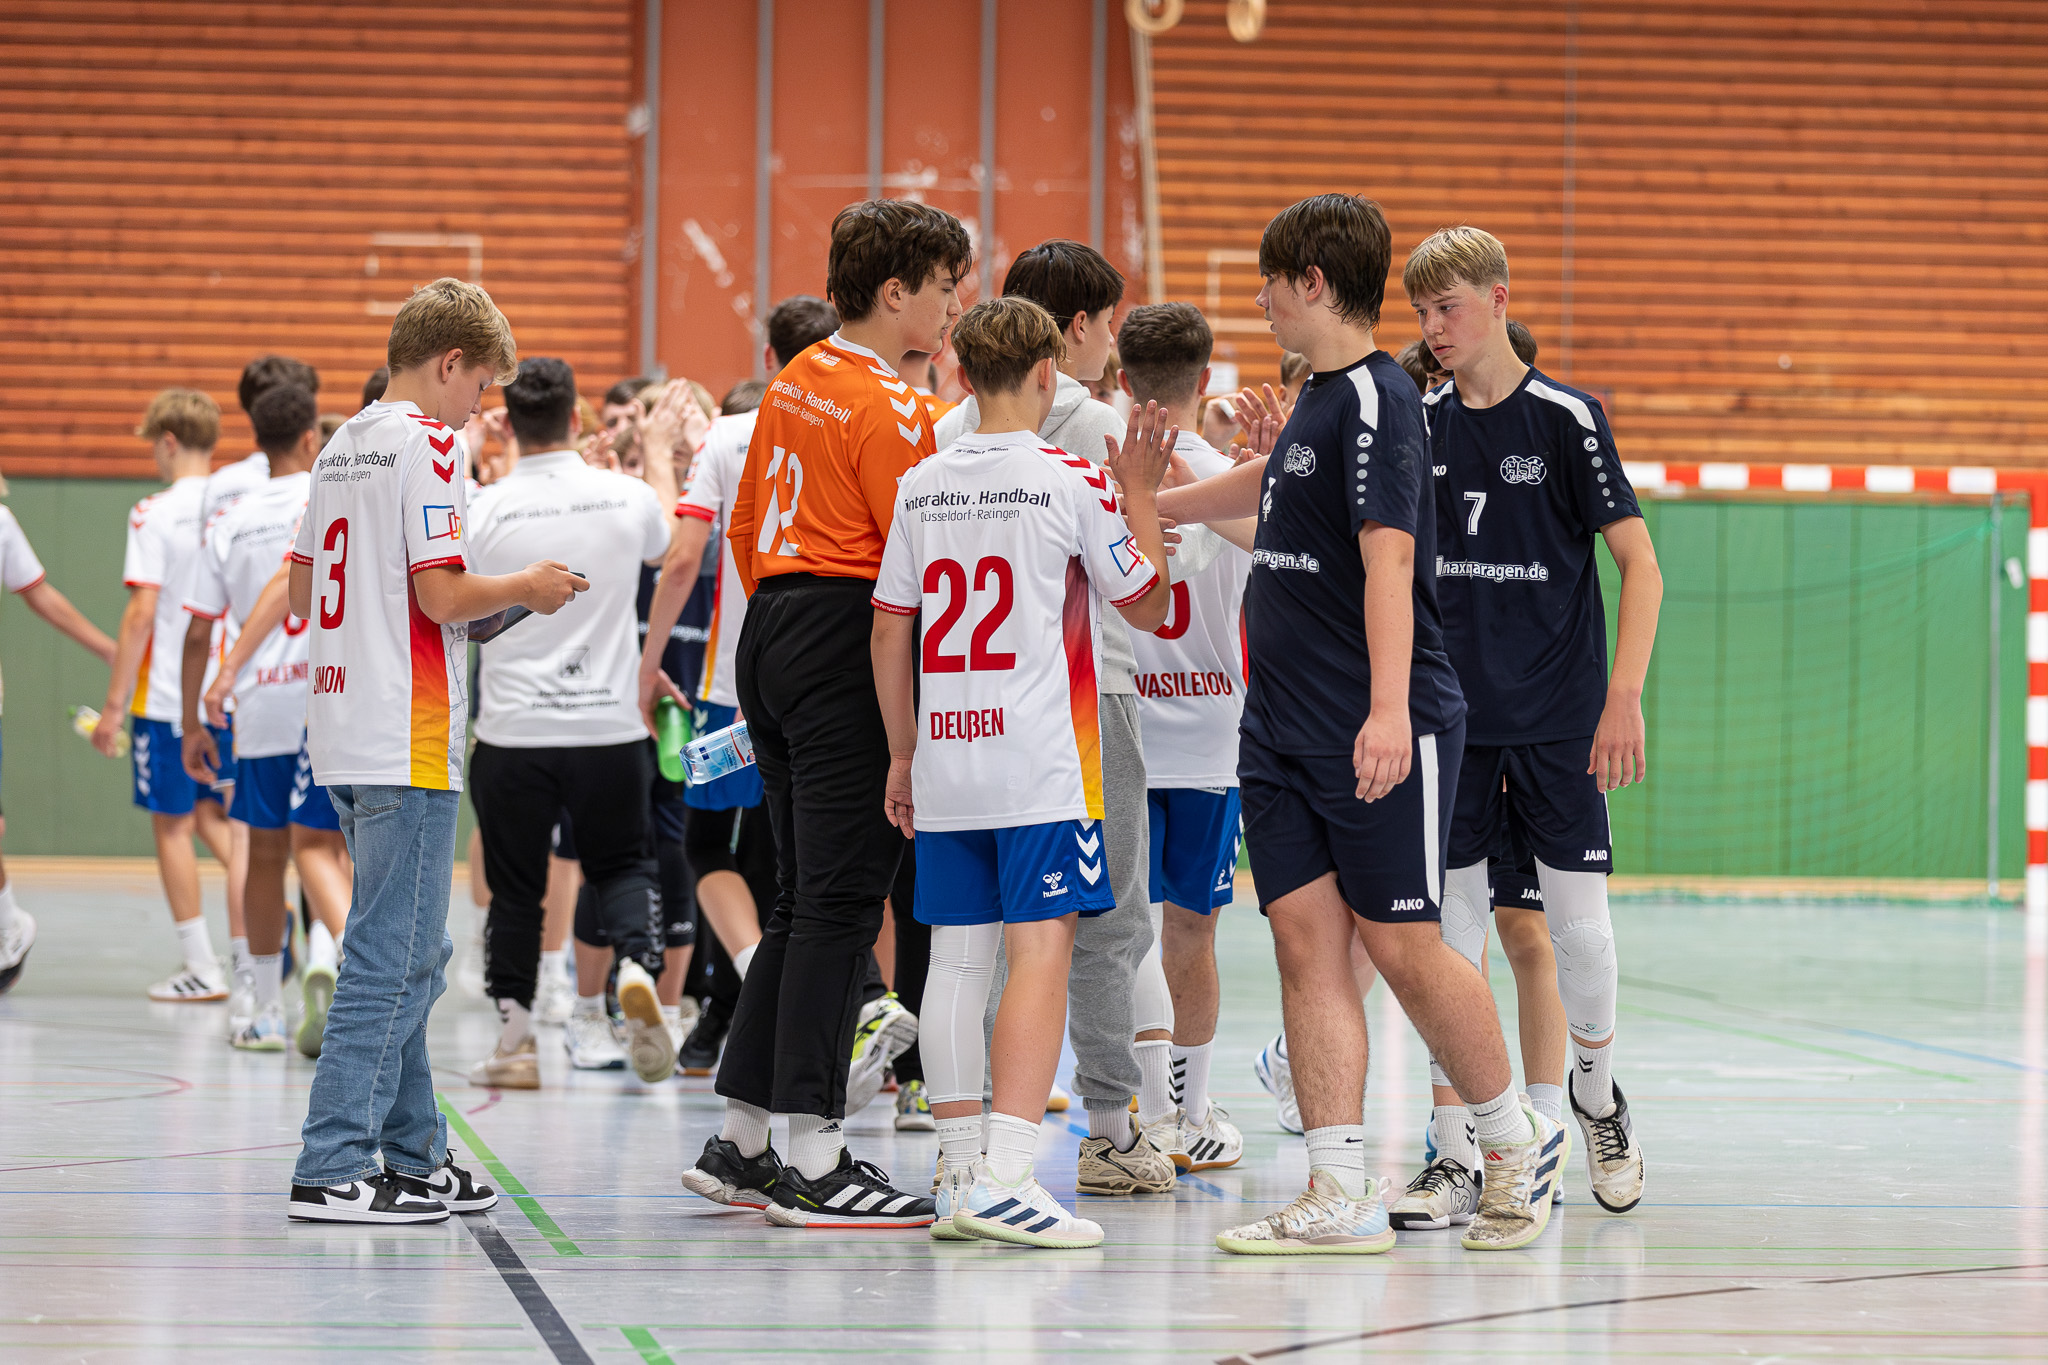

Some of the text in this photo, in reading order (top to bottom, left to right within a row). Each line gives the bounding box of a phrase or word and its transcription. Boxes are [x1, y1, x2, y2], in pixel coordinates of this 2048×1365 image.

[805, 391, 852, 424] Handball
[757, 445, 804, 557] 12
[978, 487, 1051, 508] Handball
[1463, 491, 1488, 536] 7
[319, 517, 349, 630] 3
[921, 555, 1017, 674] 22
[313, 665, 347, 695] SMON
[1133, 671, 1233, 699] VASILEIOU
[1583, 849, 1608, 861] JAKO
[1042, 885, 1069, 899] hummel
[1390, 898, 1425, 911] JAKO
